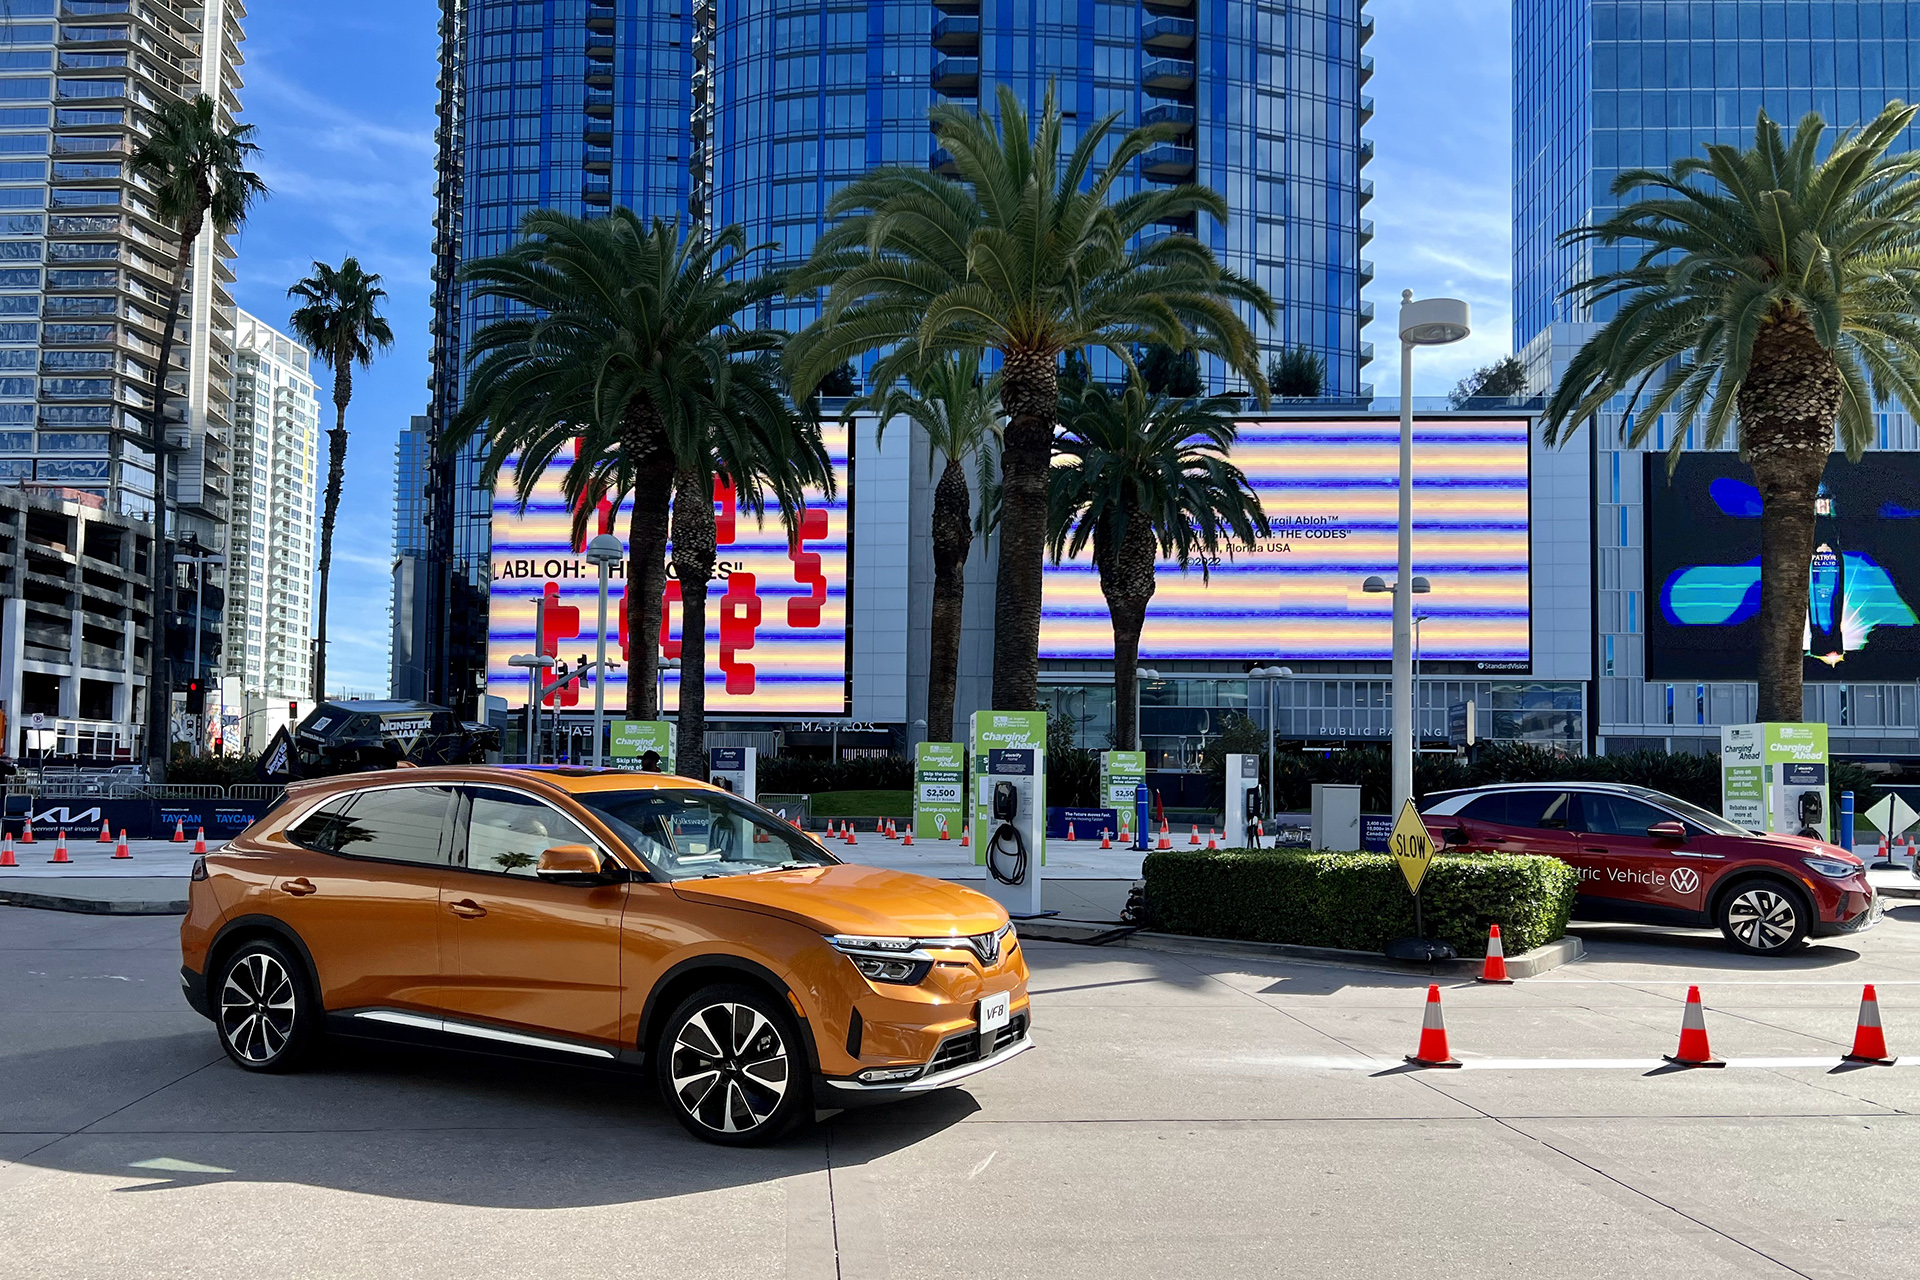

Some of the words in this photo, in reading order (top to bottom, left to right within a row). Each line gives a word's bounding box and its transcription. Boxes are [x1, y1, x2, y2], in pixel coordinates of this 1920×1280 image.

[1279, 530, 1302, 538] THE
[1305, 530, 1352, 538] CODES"
[1267, 543, 1290, 552] USA
[502, 560, 586, 578] ABLOH:
[380, 720, 431, 731] MONSTER
[1320, 728, 1371, 736] PUBLIC
[982, 732, 1028, 742] Charging
[616, 738, 654, 746] Charging
[1725, 744, 1753, 753] Charging
[1770, 743, 1812, 752] Charging
[926, 789, 955, 798] $2,500
[32, 807, 100, 822] KIA
[161, 814, 201, 823] TAYCAN
[215, 814, 254, 823] TAYCAN
[1396, 833, 1426, 859] SLOW
[1606, 867, 1665, 885] Vehicle
[986, 1004, 1004, 1020] VF8
